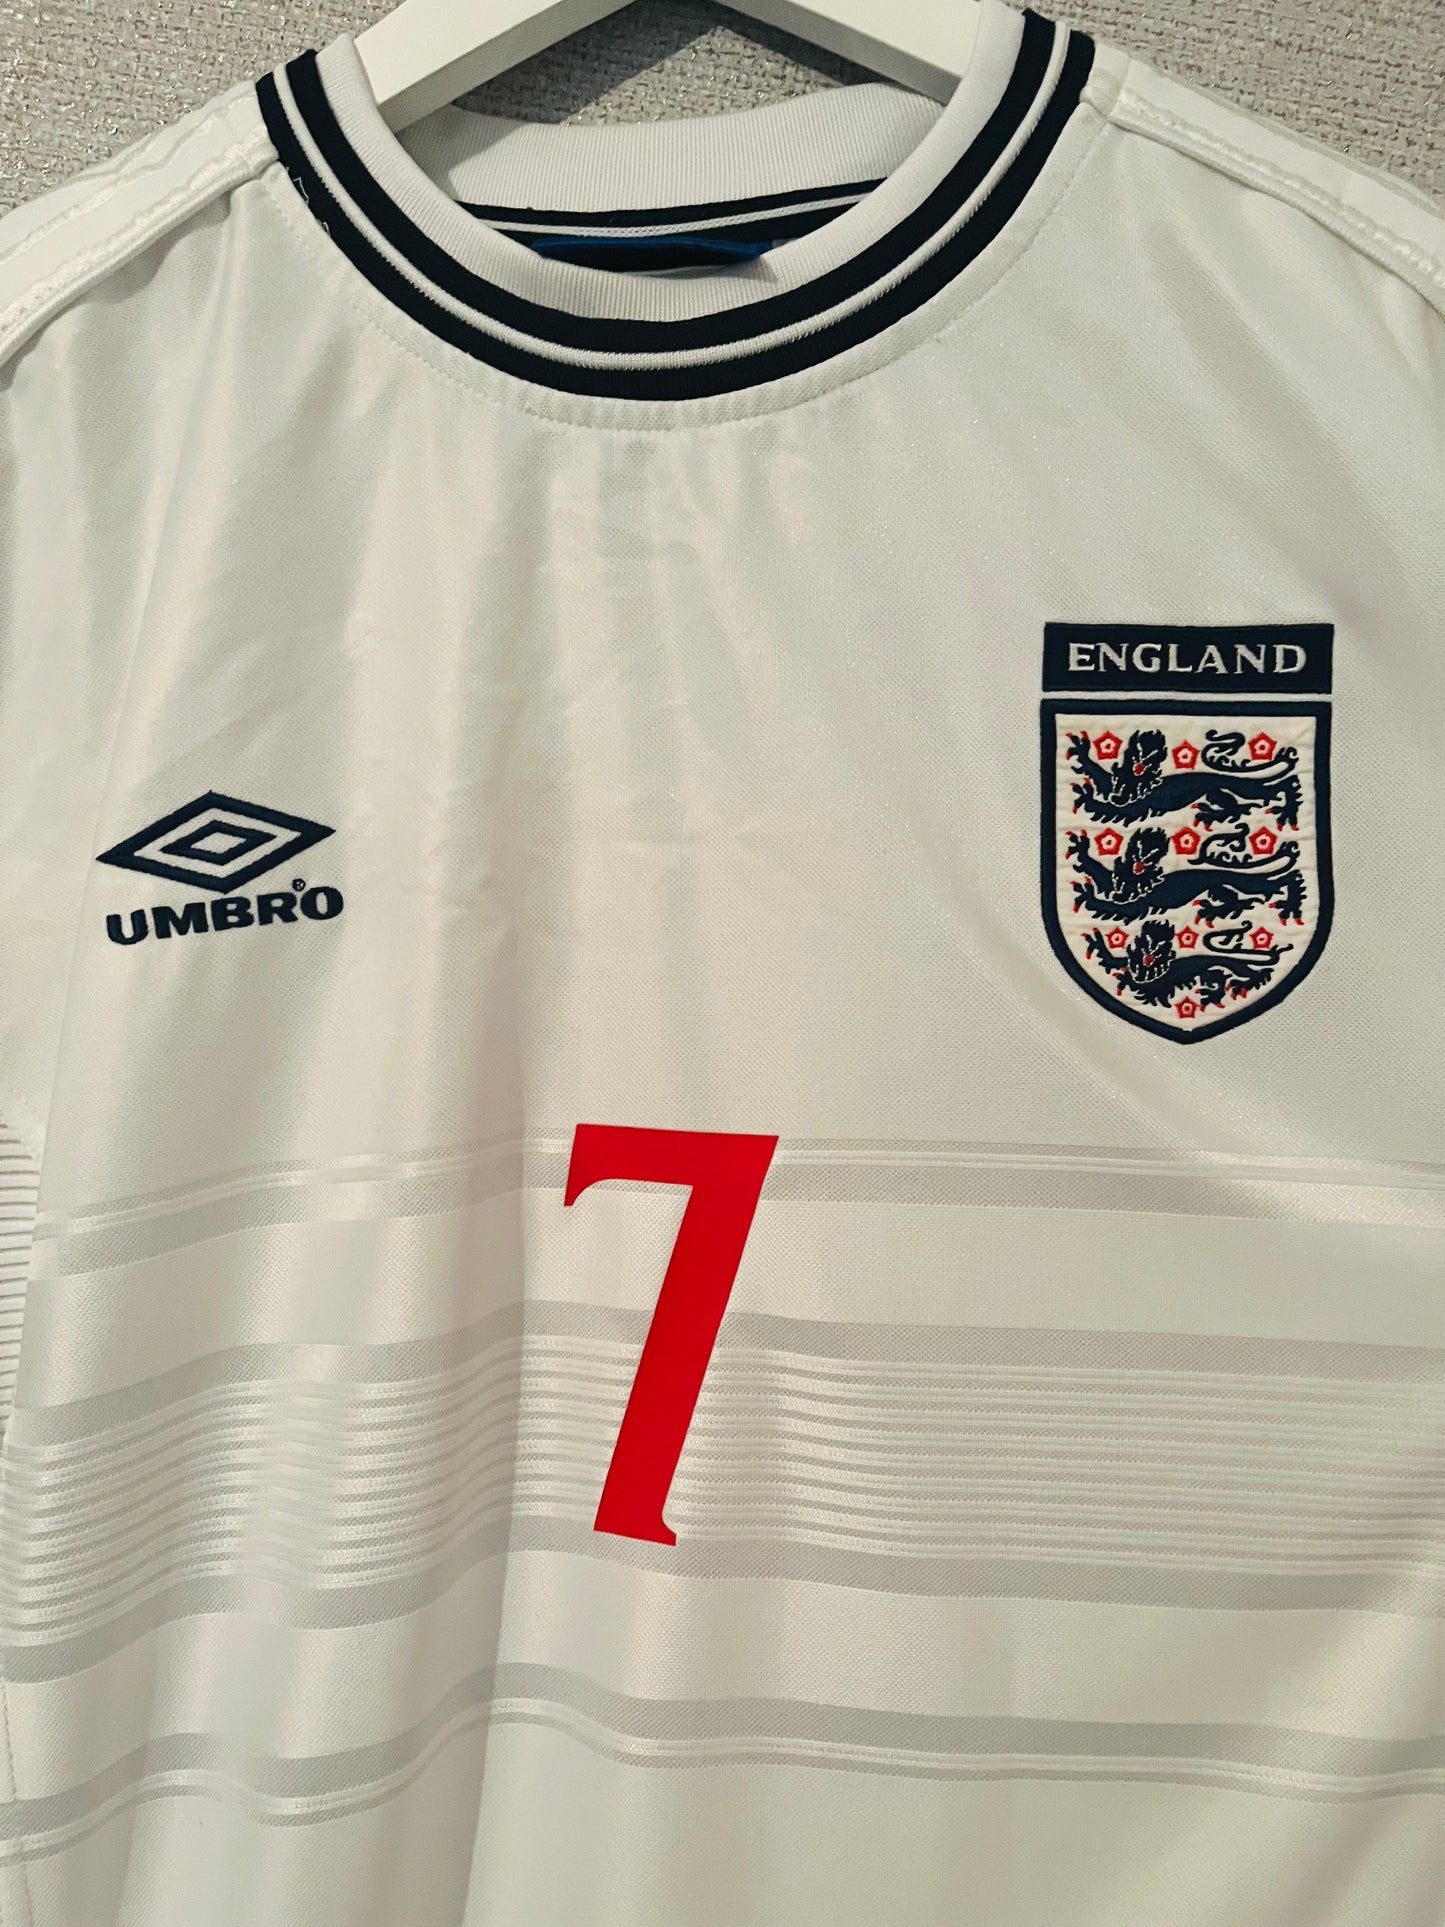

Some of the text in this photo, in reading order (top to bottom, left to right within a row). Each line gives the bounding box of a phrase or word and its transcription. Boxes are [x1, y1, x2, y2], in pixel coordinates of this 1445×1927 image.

[1068, 642, 1307, 674] ENGLAND
[106, 886, 344, 945] UMBRO
[564, 1124, 779, 1546] 7
